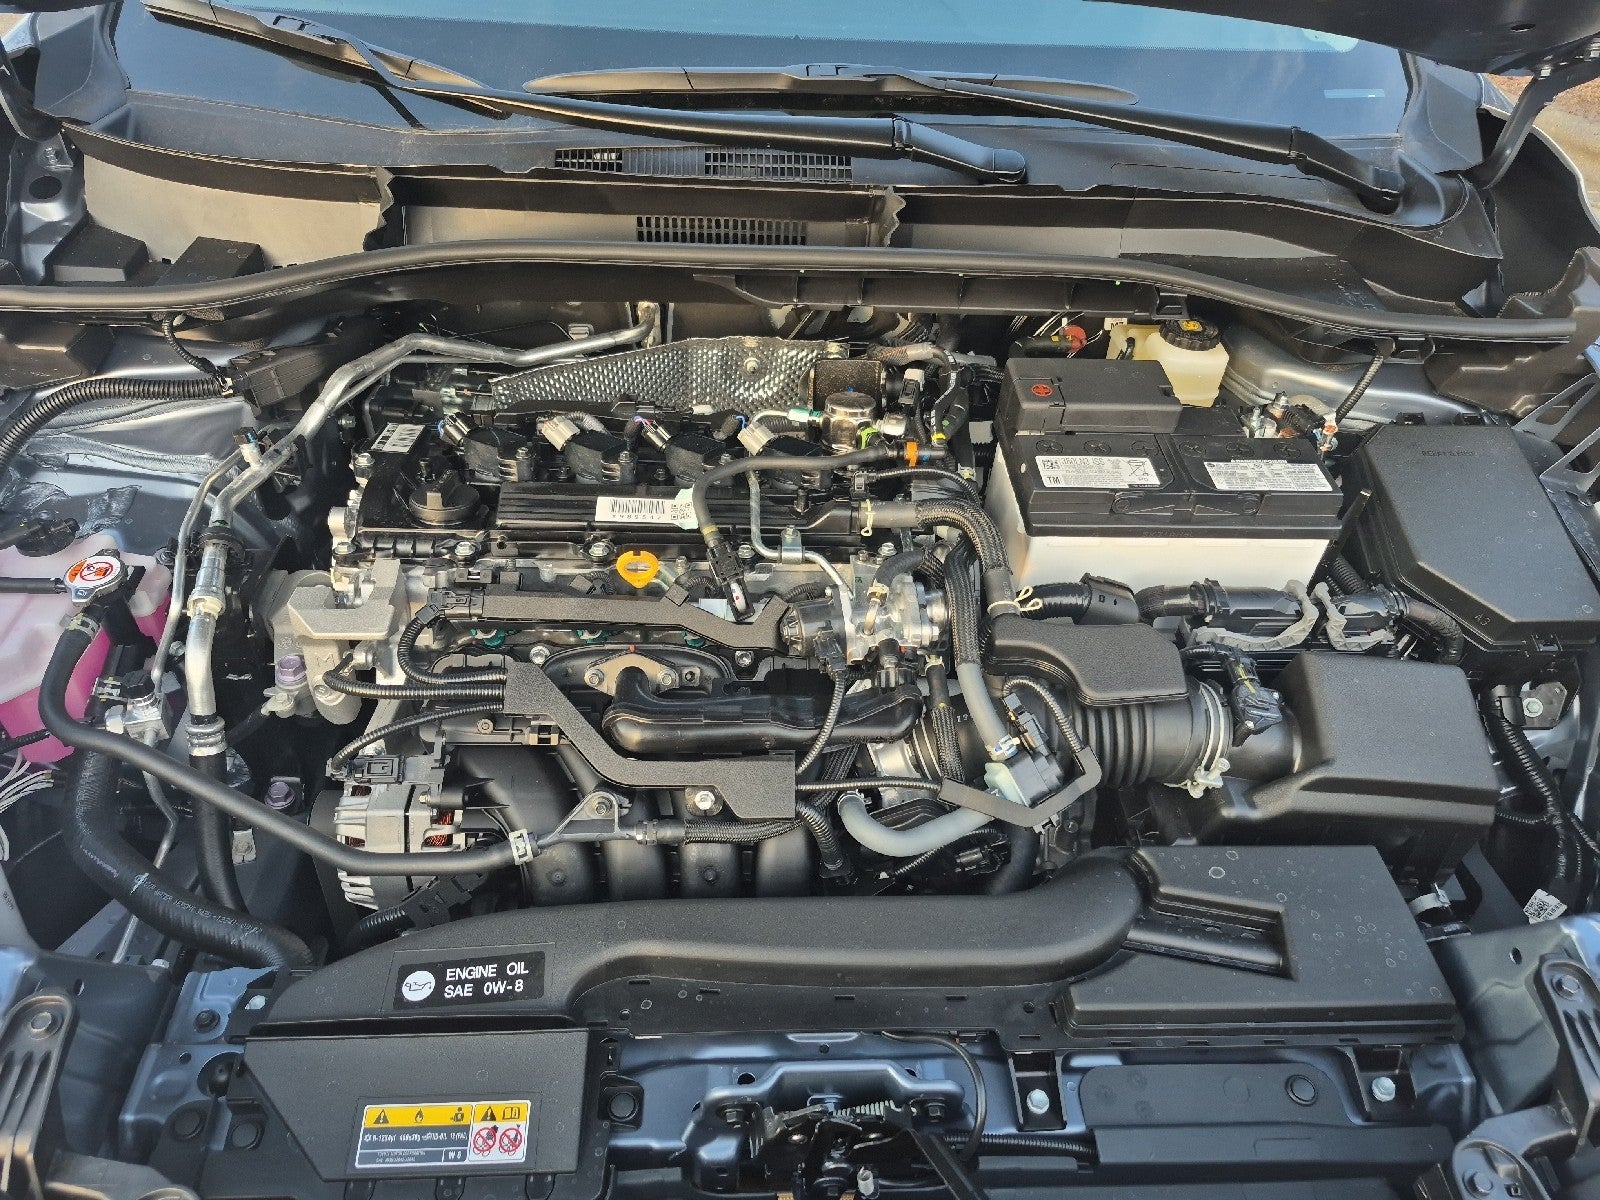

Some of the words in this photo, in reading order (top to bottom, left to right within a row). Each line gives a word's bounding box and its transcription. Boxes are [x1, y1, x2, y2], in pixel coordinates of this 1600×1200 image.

[446, 964, 497, 981] ENGINE
[506, 961, 529, 976] OIL
[444, 983, 474, 999] SAE
[483, 979, 524, 996] 0W-8
